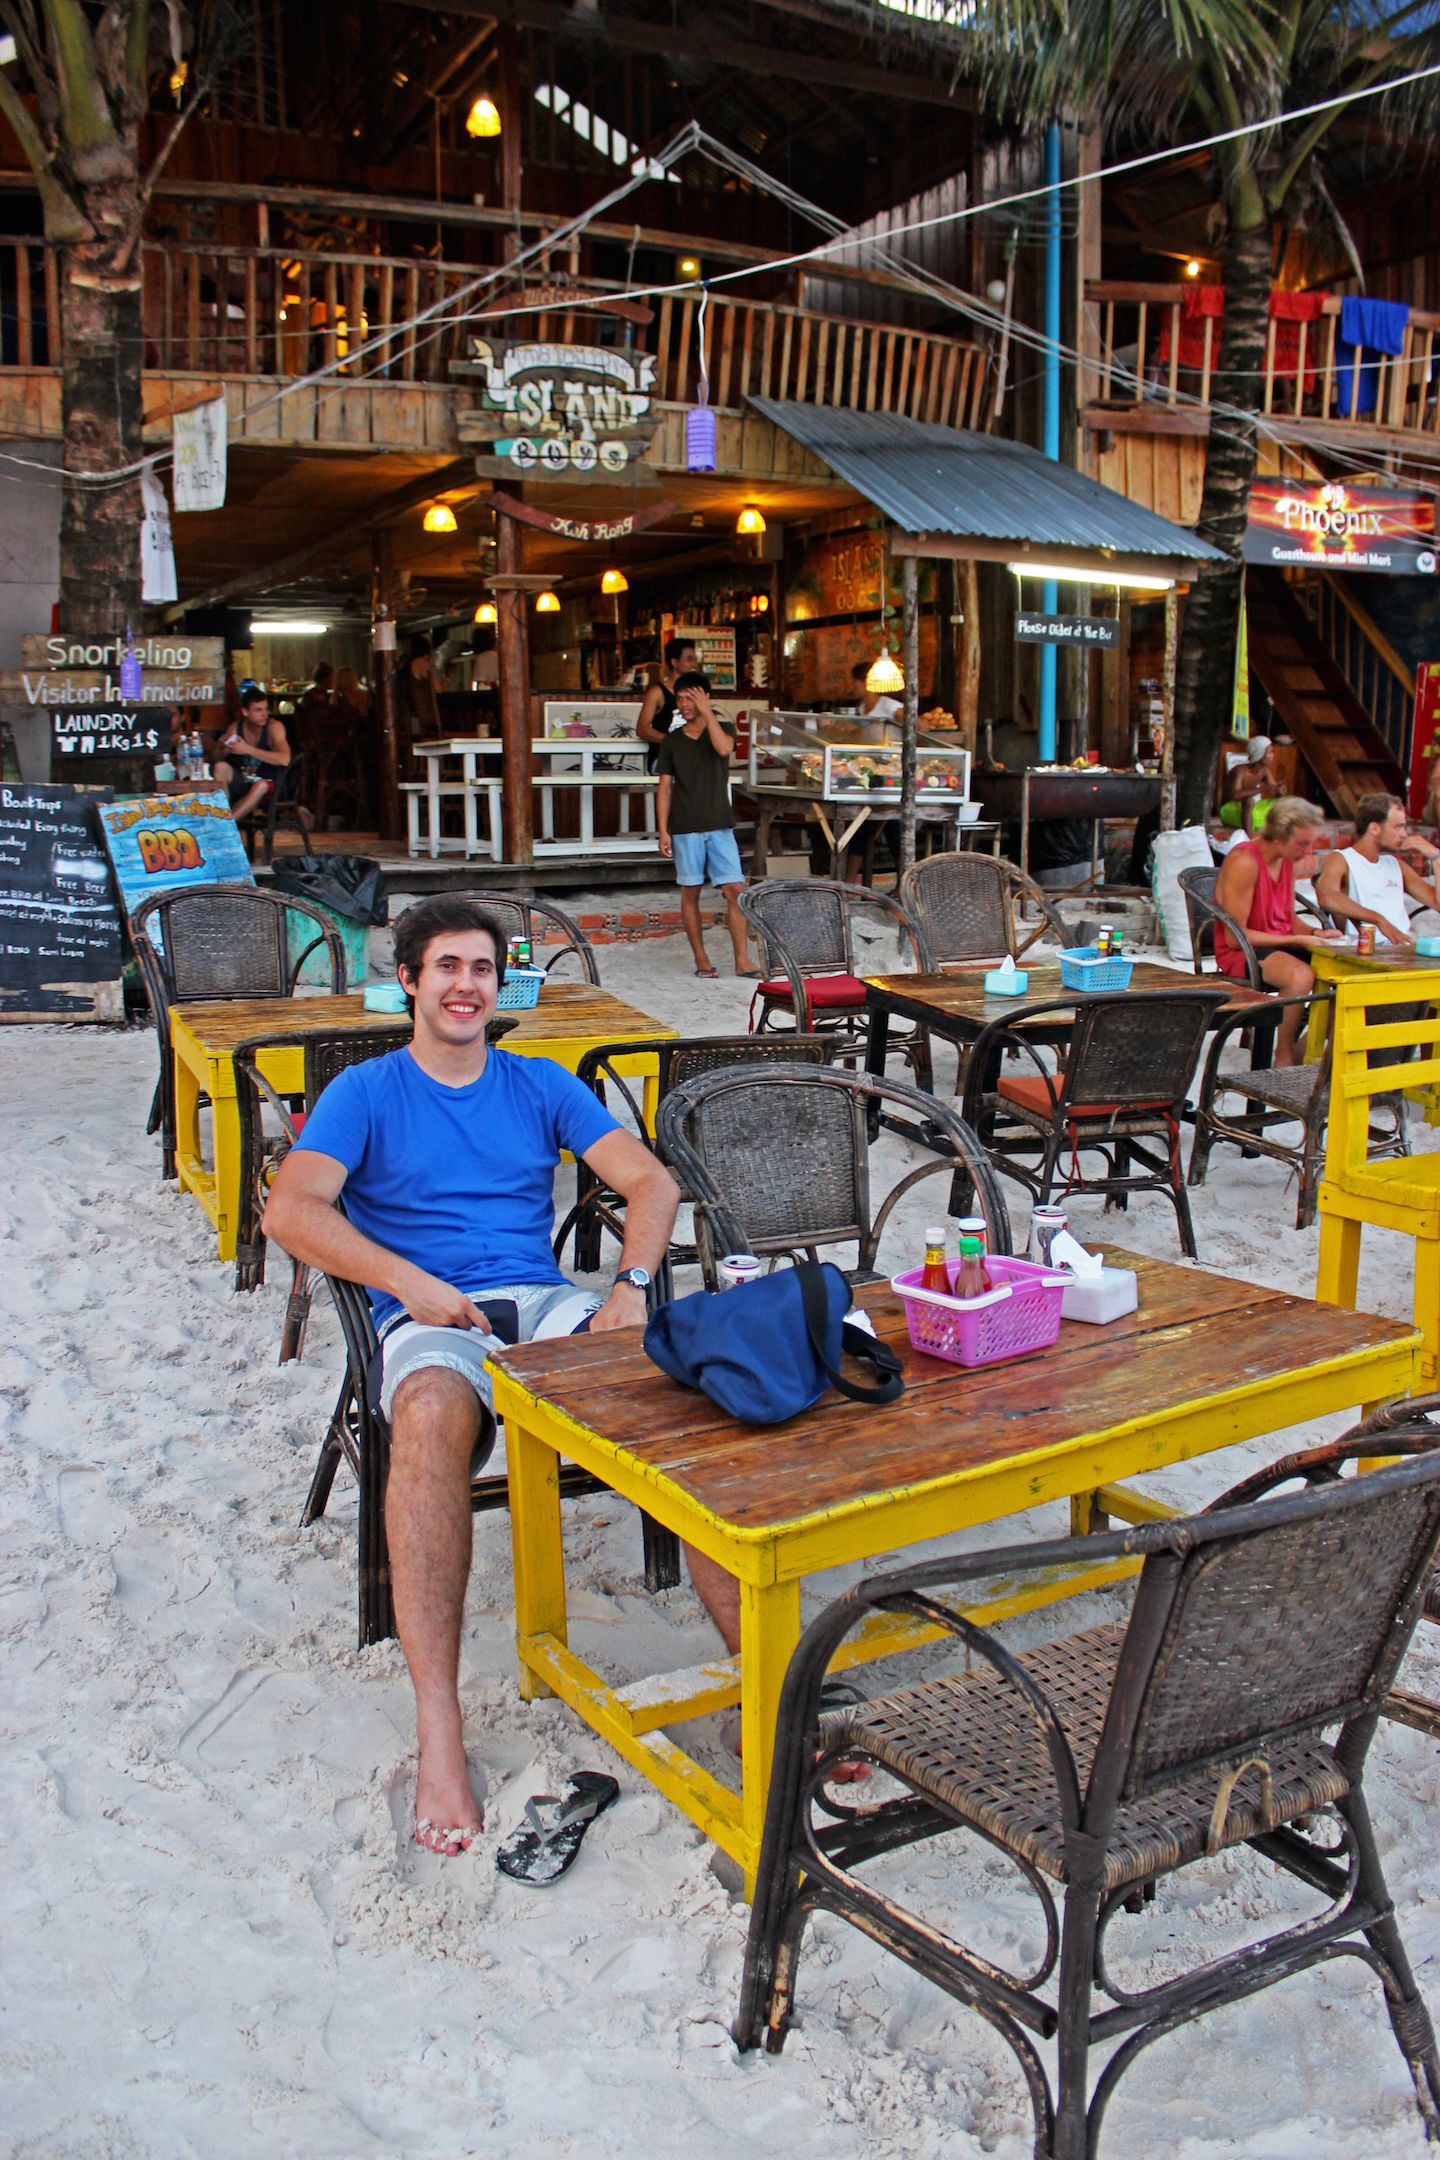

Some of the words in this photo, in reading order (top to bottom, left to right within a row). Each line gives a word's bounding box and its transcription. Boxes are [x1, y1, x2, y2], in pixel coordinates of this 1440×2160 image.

[503, 379, 650, 441] ISLAND
[511, 438, 627, 471] BOYS
[594, 516, 633, 540] Rong
[1276, 497, 1384, 535] Phoenix
[1272, 546, 1326, 563] Guesthouse
[1328, 551, 1346, 565] and
[1348, 552, 1368, 565] Mini
[1369, 553, 1391, 567] Mart
[1018, 620, 1047, 634] Please
[1049, 623, 1072, 637] Order
[47, 637, 192, 669] Snorkeling
[21, 674, 101, 704] Visitor
[105, 675, 213, 707] Inrmation
[55, 713, 137, 733] LAUNDRY
[2, 789, 35, 808] Boat
[35, 798, 61, 814] Trips
[136, 828, 206, 873] BBQ
[56, 877, 77, 890] Free
